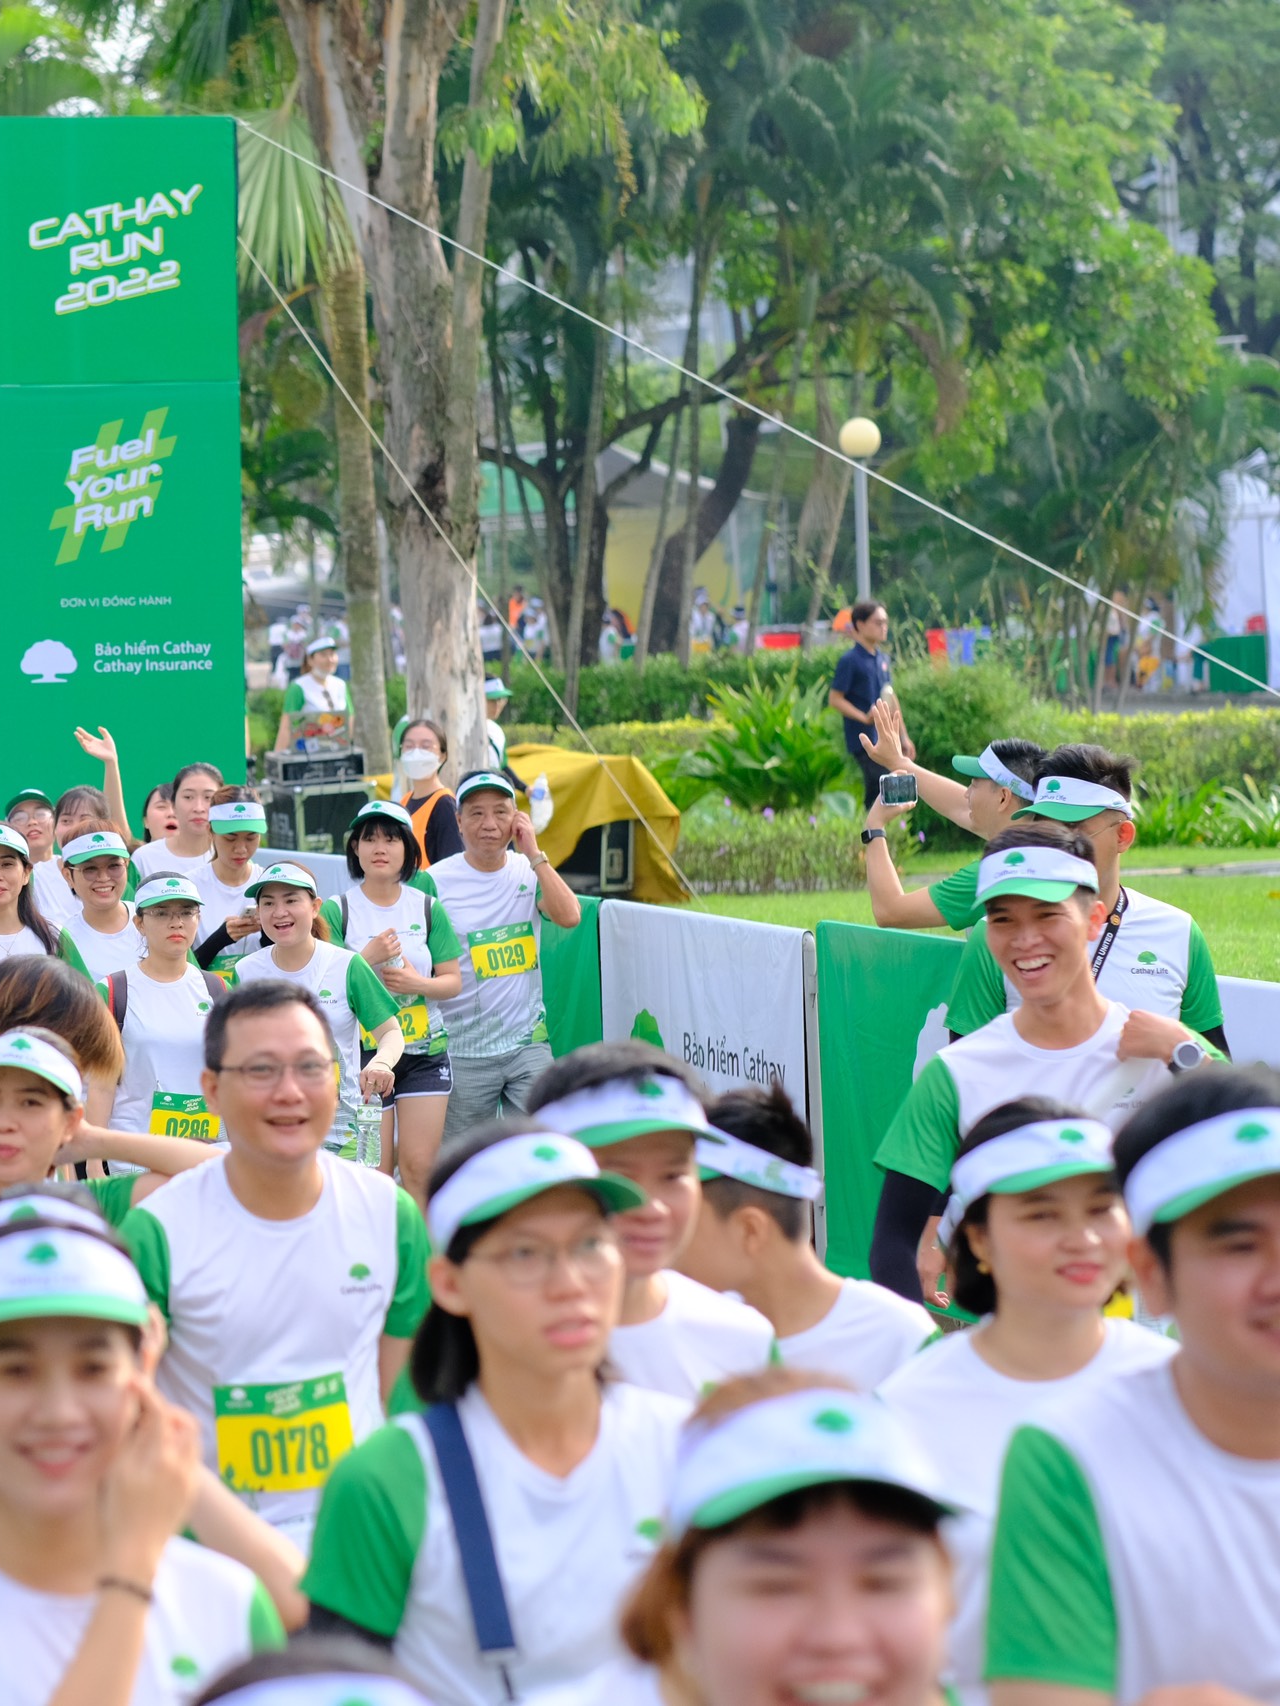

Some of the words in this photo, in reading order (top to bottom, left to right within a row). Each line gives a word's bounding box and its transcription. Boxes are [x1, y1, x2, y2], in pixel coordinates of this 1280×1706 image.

[29, 183, 203, 250] CATHAY
[70, 226, 164, 275] RUN
[55, 260, 181, 316] 2022
[70, 428, 156, 479] Fuel
[65, 463, 163, 507] Your
[73, 495, 154, 537] Run
[93, 659, 142, 675] Cathay
[145, 659, 213, 672] Insurance
[95, 642, 122, 656] Bảo
[124, 640, 160, 655] hiểm
[163, 640, 211, 657] Cathay
[487, 943, 526, 971] 0129
[1098, 932, 1114, 956] UNITED
[1130, 967, 1155, 975] Cathay
[1156, 967, 1169, 975] Life
[683, 1031, 705, 1069] Bảo
[707, 1035, 740, 1078] hiểm
[743, 1046, 786, 1088] Cathay
[165, 1117, 210, 1139] 0286
[249, 1423, 329, 1477] 0178
